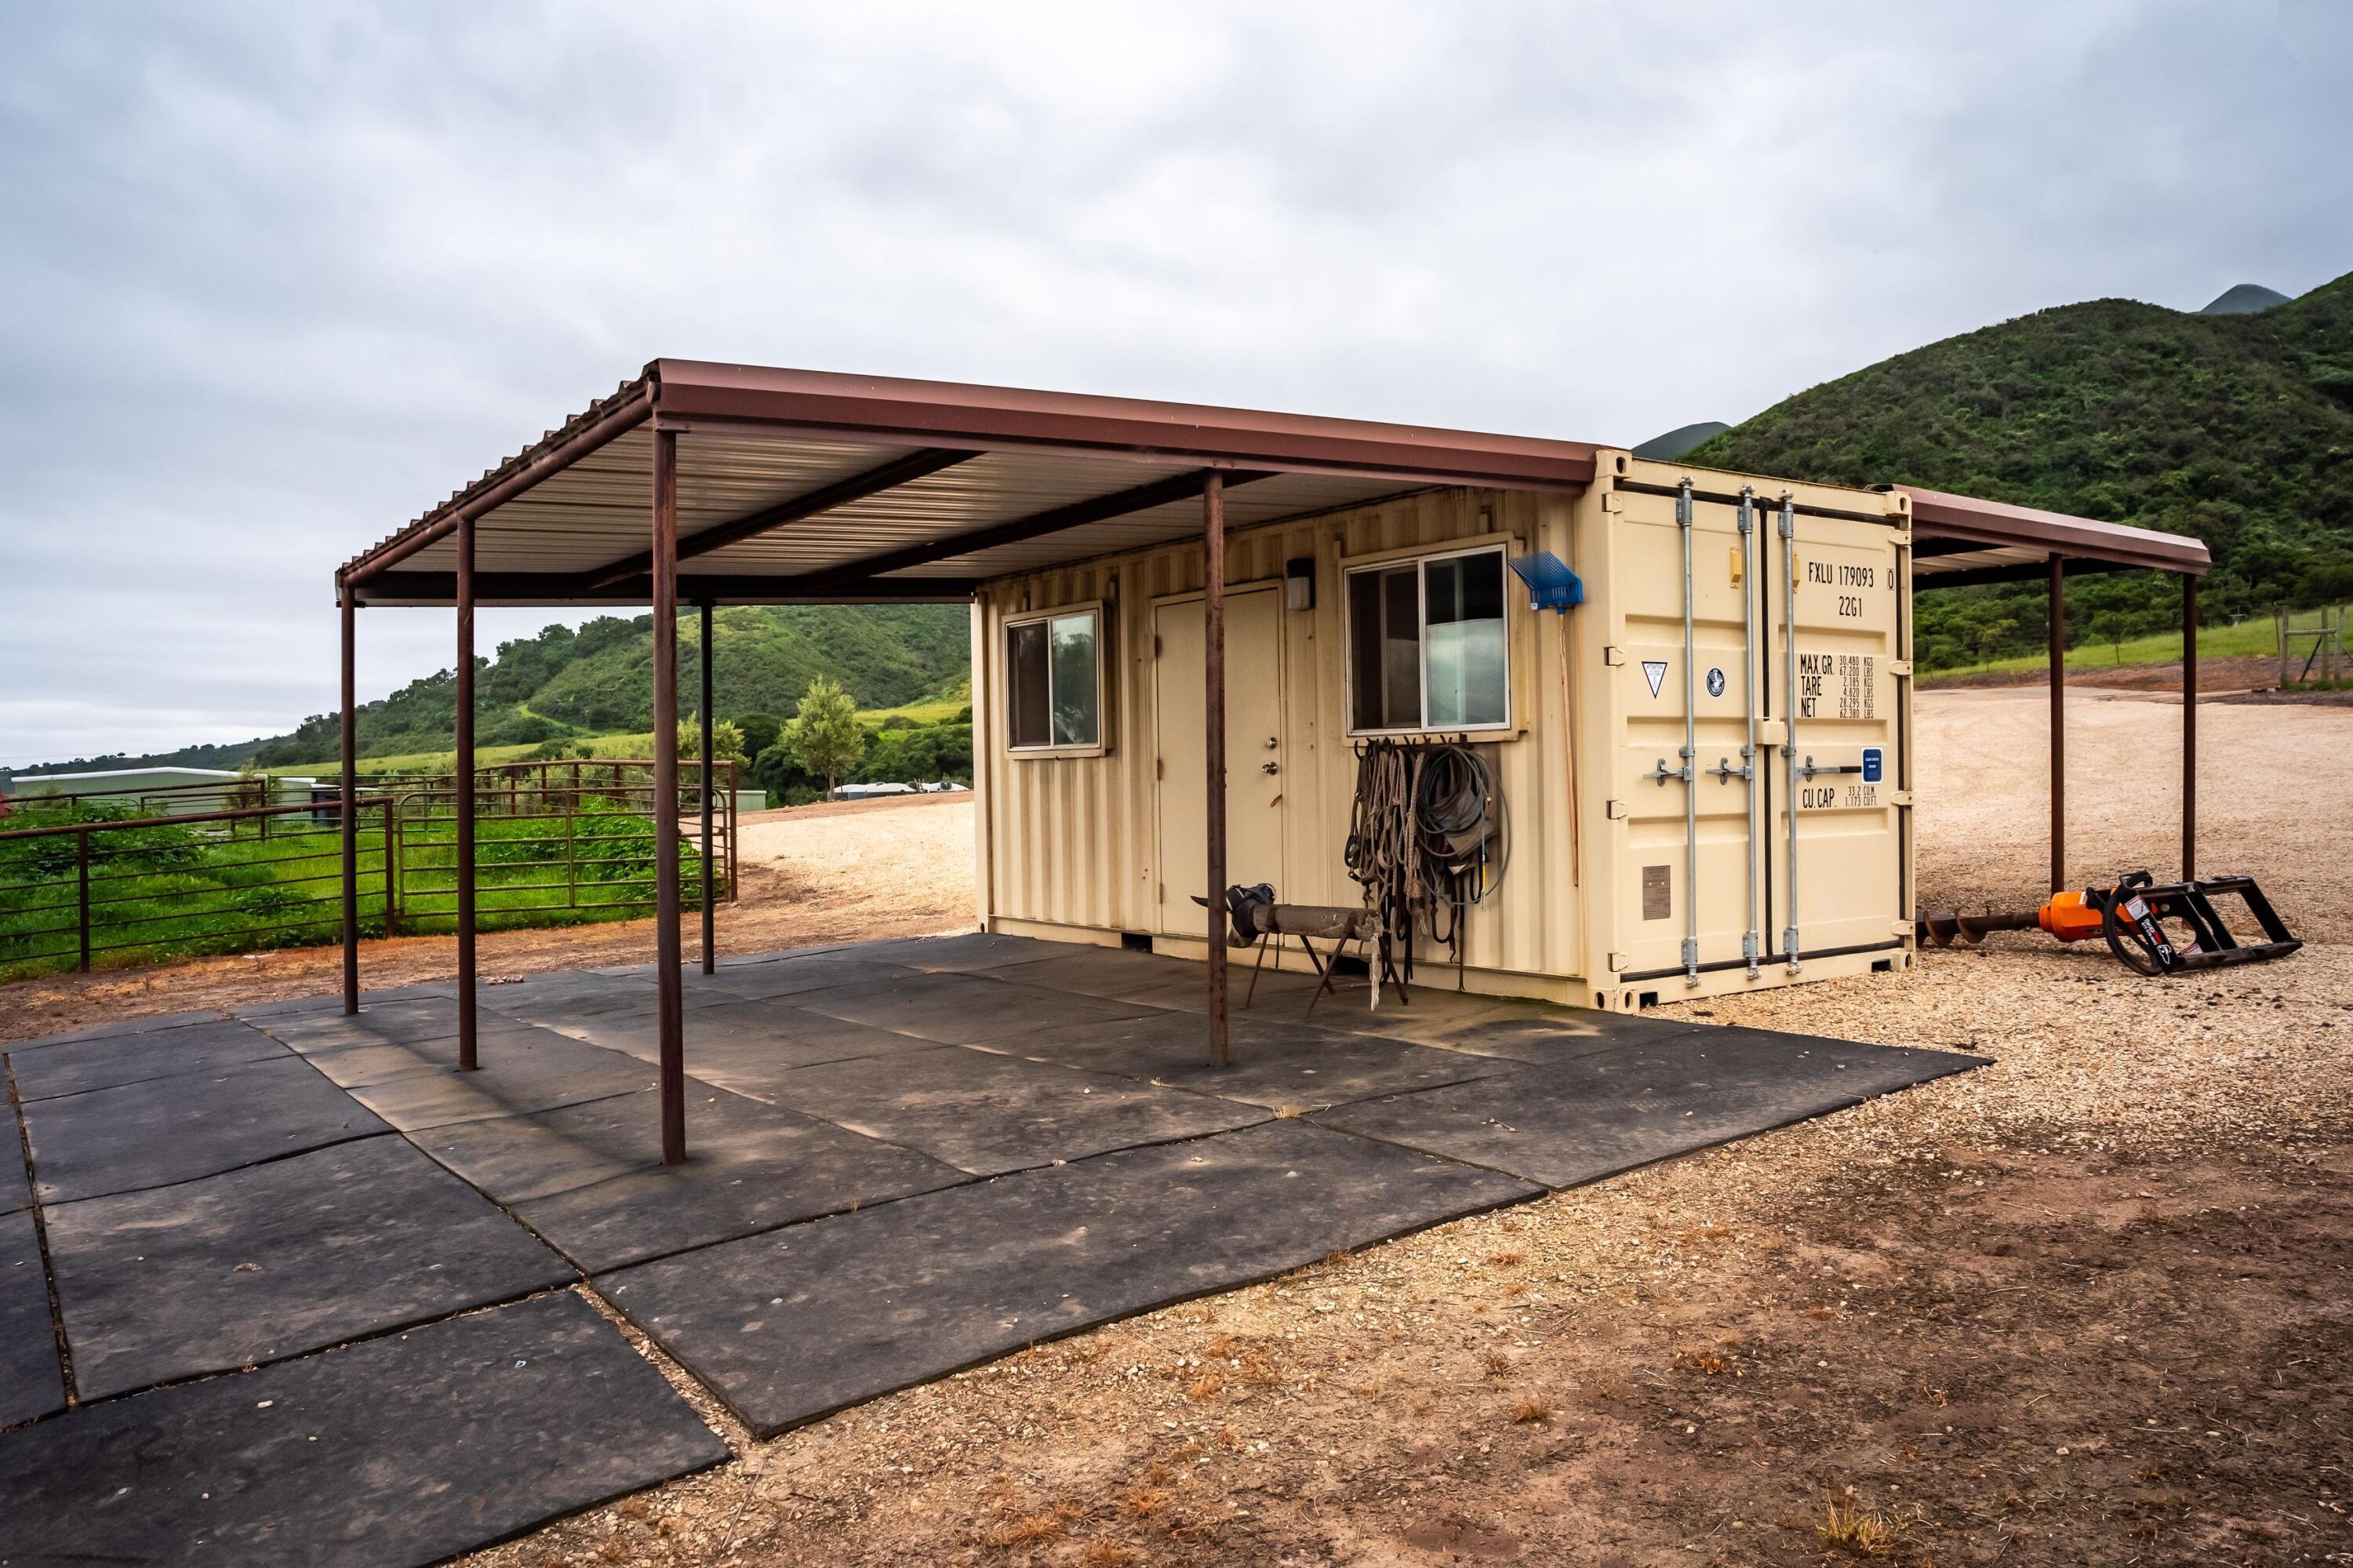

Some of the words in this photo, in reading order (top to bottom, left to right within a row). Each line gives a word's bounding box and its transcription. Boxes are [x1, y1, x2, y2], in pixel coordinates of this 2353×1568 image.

[1809, 562, 1833, 584] FXLU
[1838, 566, 1874, 588] 179093
[1888, 569, 1894, 589] 0
[1838, 596, 1862, 617] 22G1
[1864, 657, 1874, 667] KGS
[1864, 667, 1874, 677] LBS
[1801, 676, 1822, 696] TARE
[1864, 678, 1874, 688] KGS
[1864, 688, 1874, 698] LBS
[1801, 697, 1817, 718] NET
[1864, 698, 1874, 708] KGS
[1864, 708, 1874, 719] LBS
